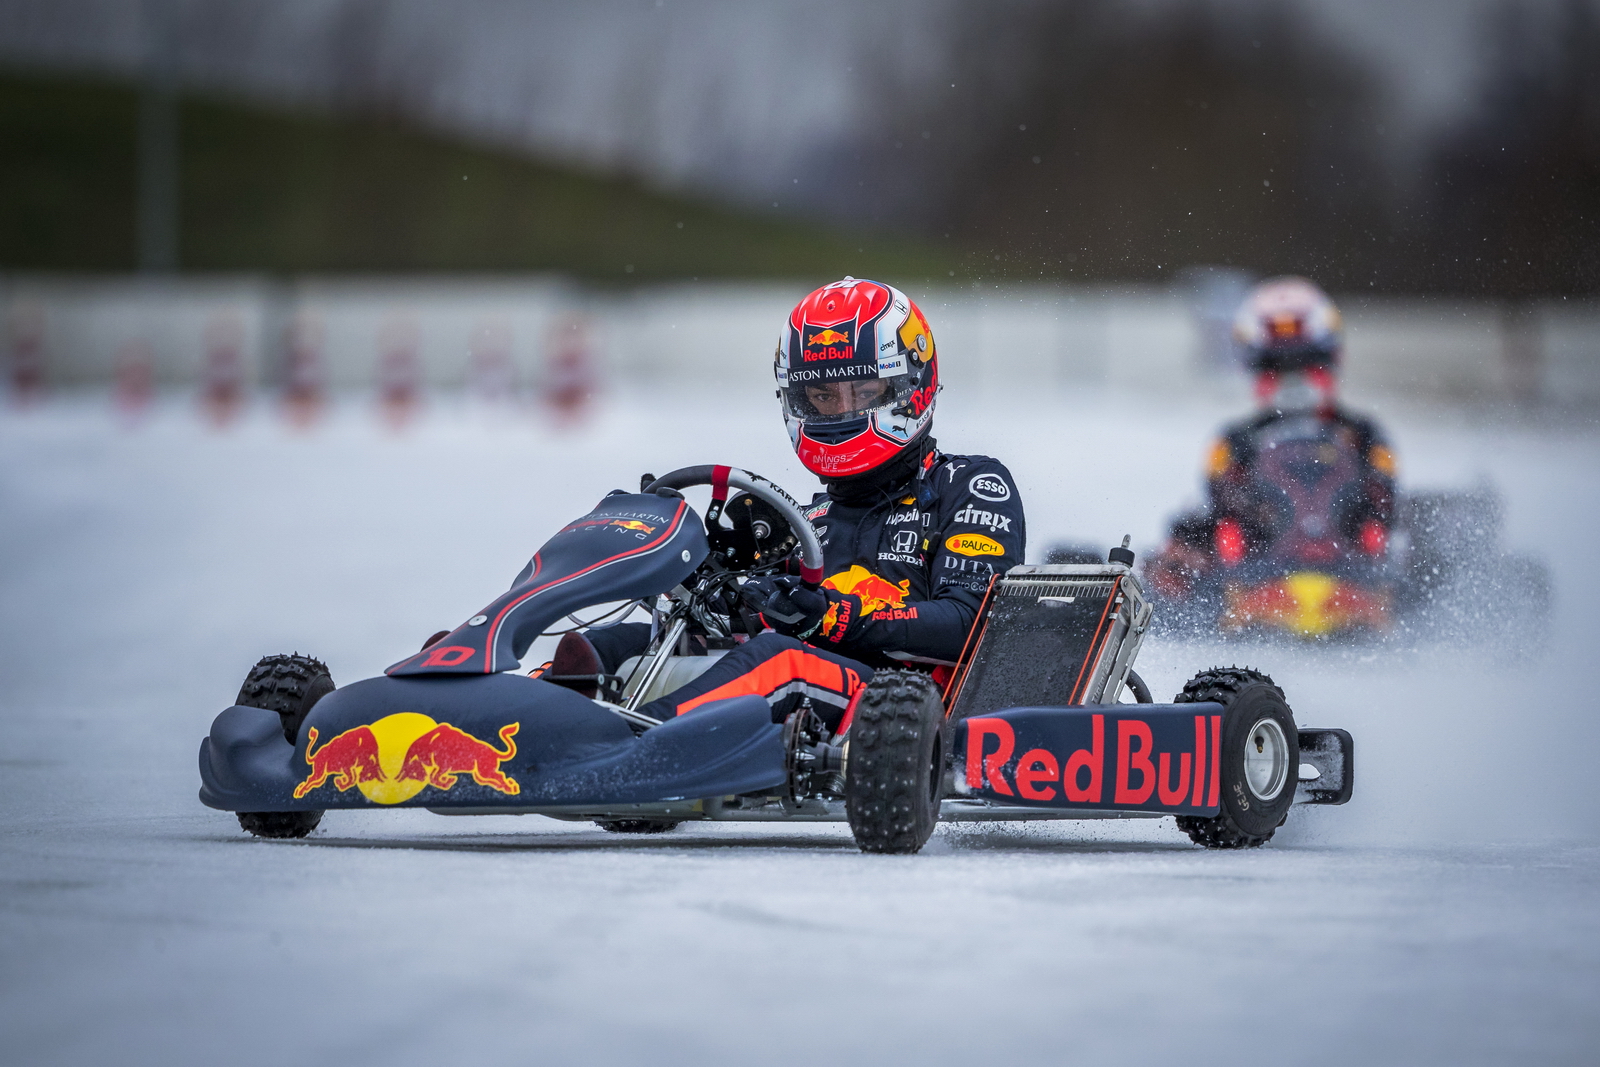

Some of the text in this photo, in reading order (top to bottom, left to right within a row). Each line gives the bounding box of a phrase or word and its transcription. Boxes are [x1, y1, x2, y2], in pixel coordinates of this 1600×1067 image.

[804, 347, 827, 362] Red
[828, 346, 853, 360] Bull
[789, 369, 820, 382] ASTON
[826, 364, 877, 378] MARTIN
[879, 362, 896, 370] Mobil
[616, 512, 669, 524] MARTIN
[886, 509, 919, 525] Mobil
[954, 504, 1012, 532] CITRIX
[961, 540, 997, 552] RAUCH
[878, 553, 923, 566] HONDA
[944, 555, 995, 575] DITA
[940, 577, 987, 592] FuturoCoi
[829, 600, 852, 643] Red Bull
[872, 607, 918, 621] Red Bull
[966, 714, 1221, 807] Red Bull
